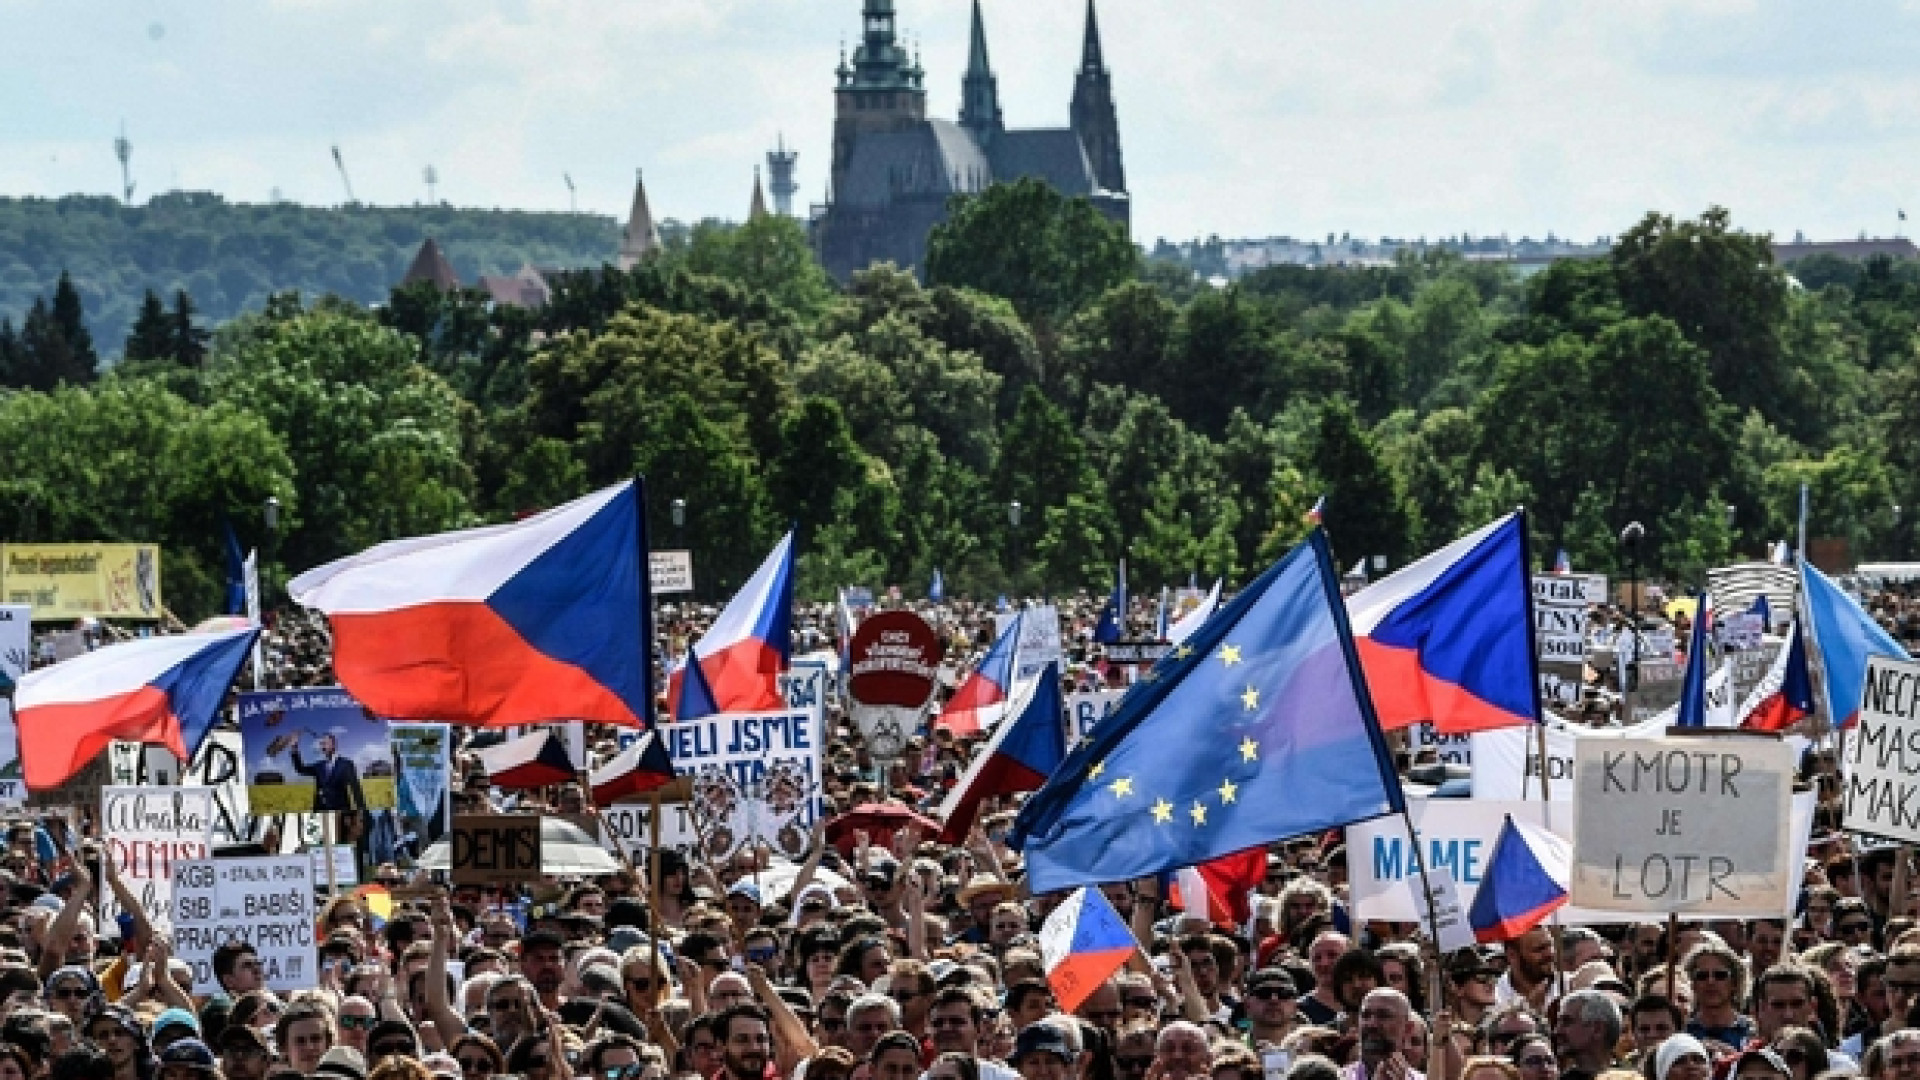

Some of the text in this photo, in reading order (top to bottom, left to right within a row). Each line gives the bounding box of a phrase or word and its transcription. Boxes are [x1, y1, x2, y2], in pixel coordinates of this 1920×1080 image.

[1602, 750, 1741, 798] KMOTR
[1848, 773, 1920, 830] MAK
[1656, 809, 1682, 836] JE
[175, 864, 215, 889] KGB
[1612, 853, 1740, 901] LOTR
[256, 917, 311, 948] PRYČ
